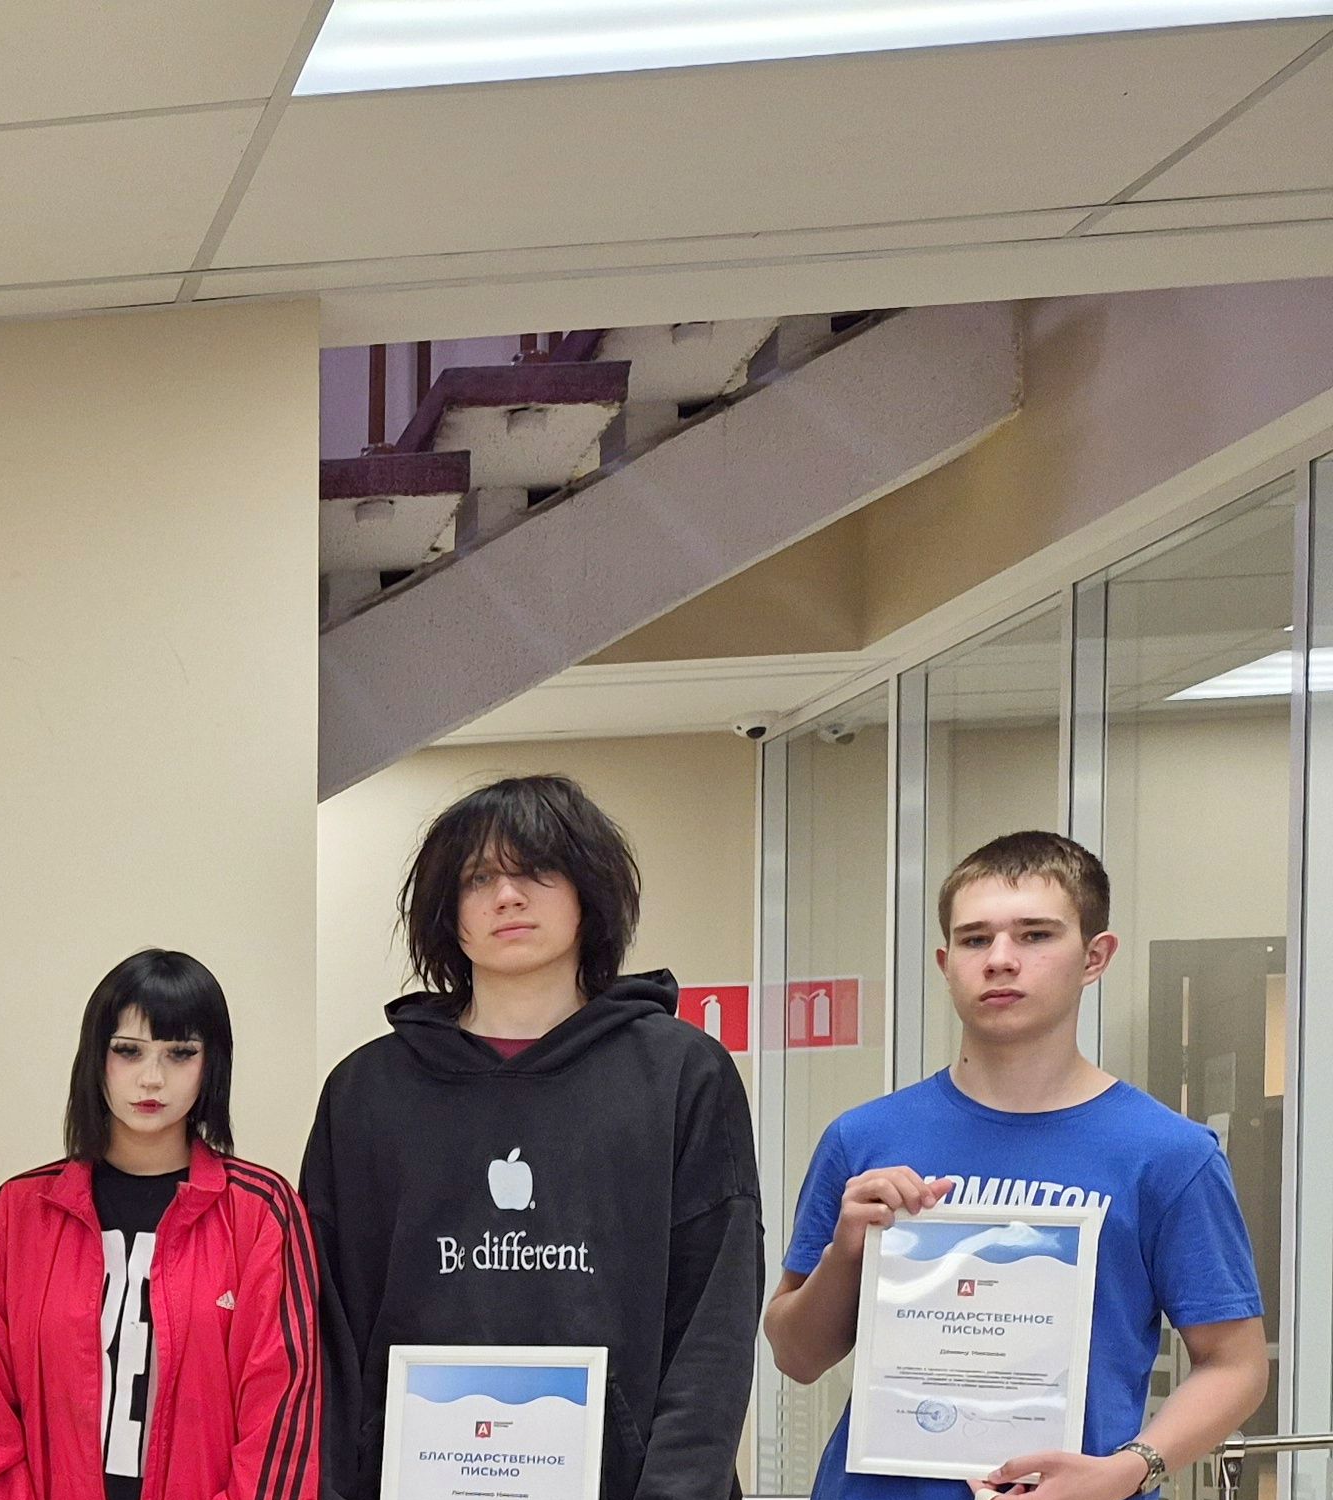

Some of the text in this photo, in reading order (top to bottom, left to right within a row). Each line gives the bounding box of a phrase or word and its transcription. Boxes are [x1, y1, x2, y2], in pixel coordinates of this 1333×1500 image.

[436, 1230, 595, 1275] Be different.
[896, 1309, 1054, 1325] БЛАГОДАРСТВЕННОЕ
[942, 1325, 1005, 1337] ПИСЬМО
[419, 1451, 565, 1465] БЛАГОДАРСТВЕННОЕ
[460, 1467, 520, 1478] ПИСЬМО
